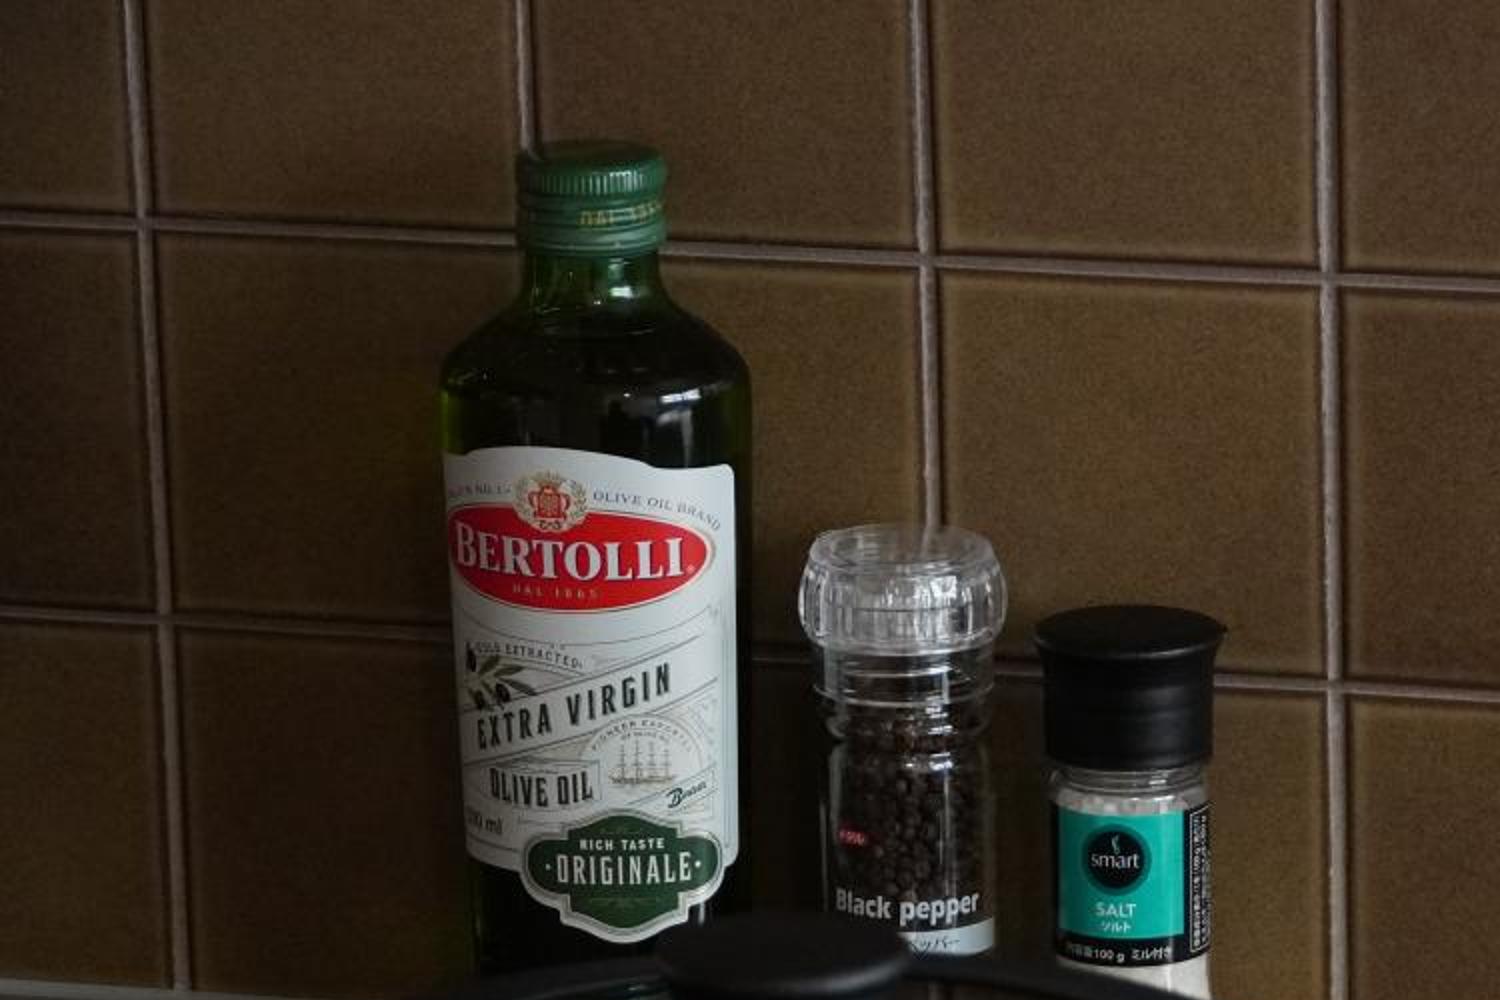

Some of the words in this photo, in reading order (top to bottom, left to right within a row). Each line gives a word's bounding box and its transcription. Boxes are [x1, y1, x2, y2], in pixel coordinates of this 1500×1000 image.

[592, 489, 642, 506] OLIVE
[646, 496, 674, 511] OIL
[677, 503, 721, 532] BRAND
[454, 520, 685, 581] BERTOLLI
[476, 703, 551, 750] EXTRA
[566, 662, 671, 726] VIRGIN
[489, 767, 549, 808] OLIVE
[557, 770, 593, 805] OIL
[579, 838, 612, 851] RICH
[621, 837, 665, 850] TASTE
[1091, 853, 1140, 870] smart
[556, 851, 692, 886] ORIGINALE
[836, 887, 891, 919] Black
[900, 892, 980, 926] pepper
[1095, 902, 1136, 918] SALT
[1101, 921, 1131, 933] ソルト
